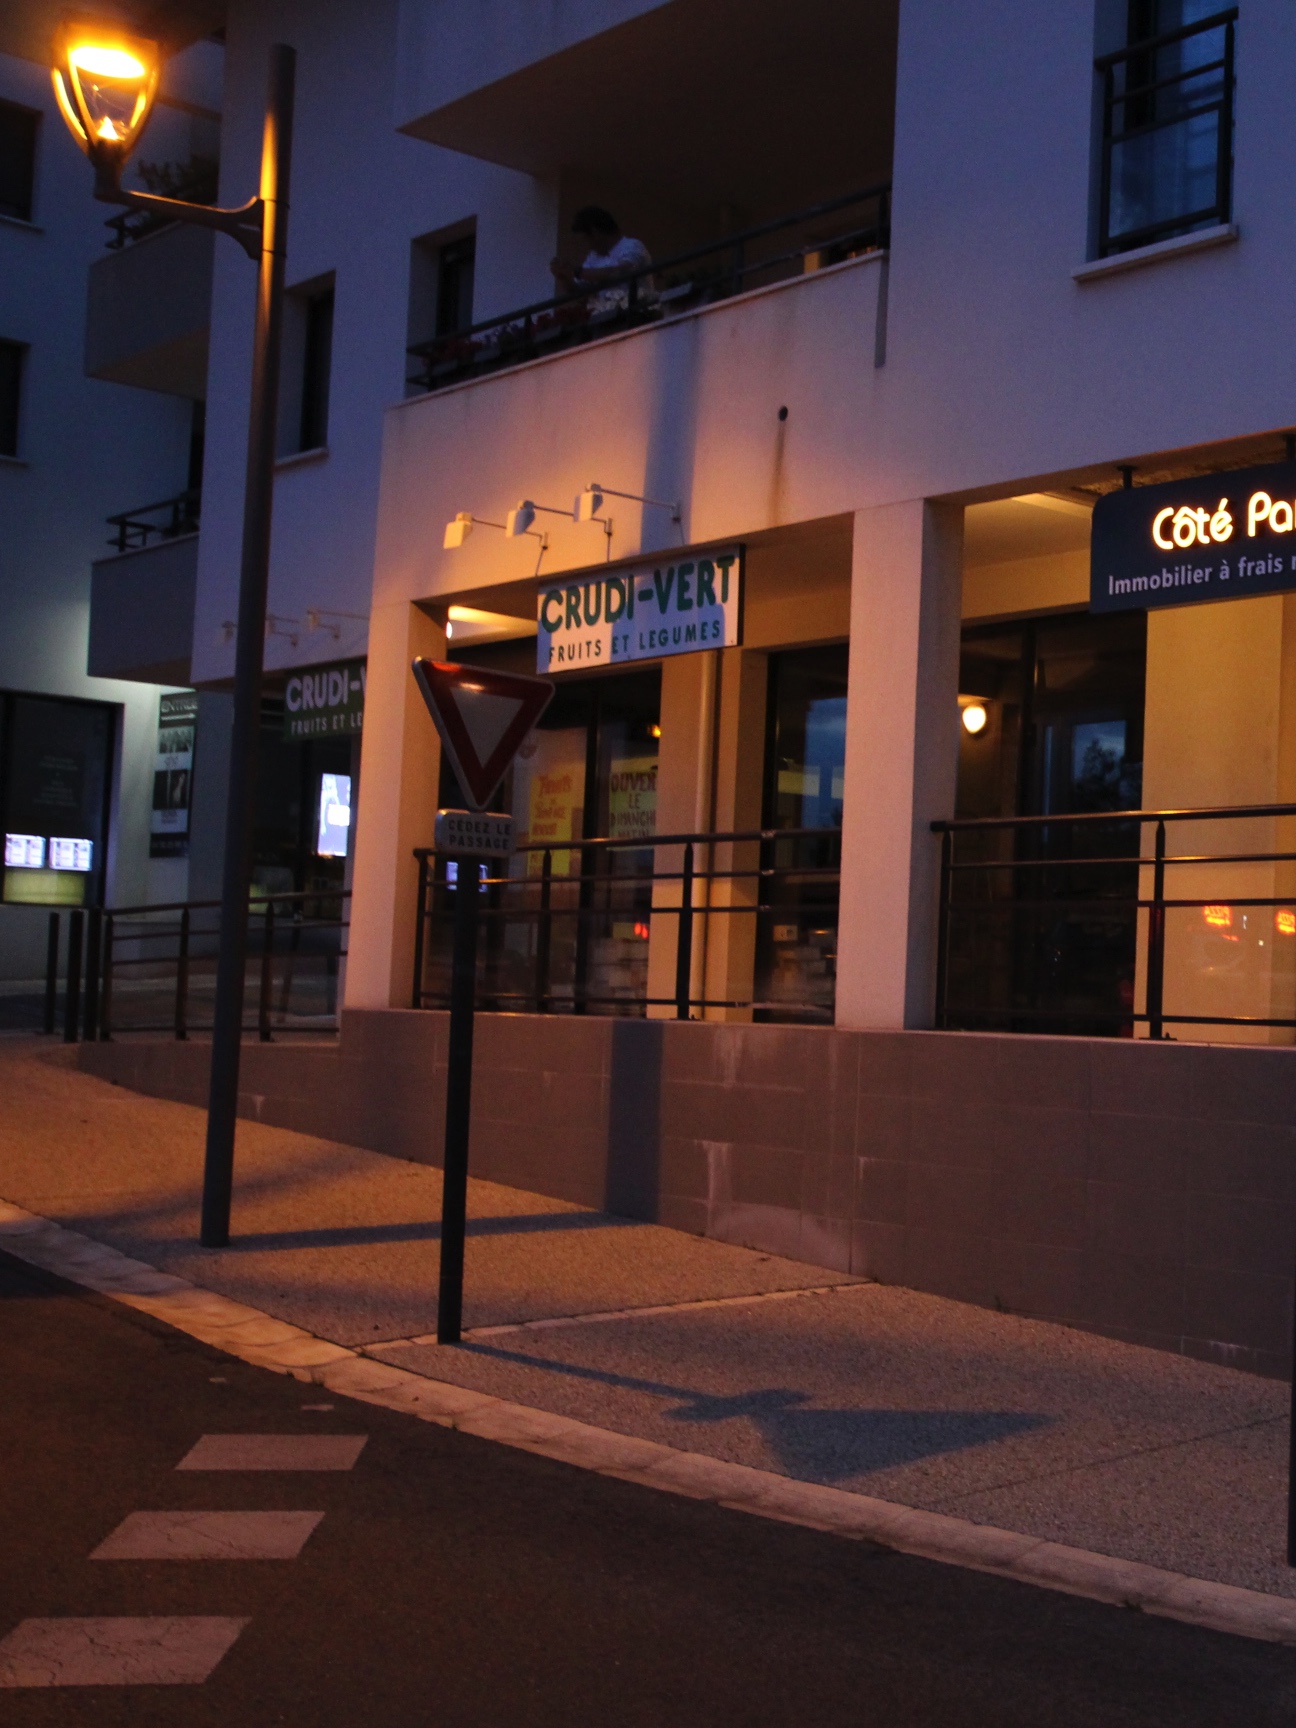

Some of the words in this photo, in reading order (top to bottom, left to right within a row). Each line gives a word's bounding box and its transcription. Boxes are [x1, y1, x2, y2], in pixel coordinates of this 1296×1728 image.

[1152, 497, 1234, 550] Côté
[1108, 563, 1212, 595] Immobilier
[1218, 559, 1231, 580] à
[1238, 551, 1283, 578] frais
[541, 555, 736, 634] CRUDI-VERT
[548, 639, 602, 663] FRUITS
[612, 637, 629, 653] ET
[639, 620, 721, 650] LEGUMES
[291, 717, 327, 736] FRUITS
[332, 713, 345, 730] ET
[611, 773, 656, 792] OUVER
[628, 793, 641, 809] LE
[610, 810, 656, 827] DIMANCH
[497, 824, 511, 835] LE
[449, 834, 509, 850] PASSAGE
